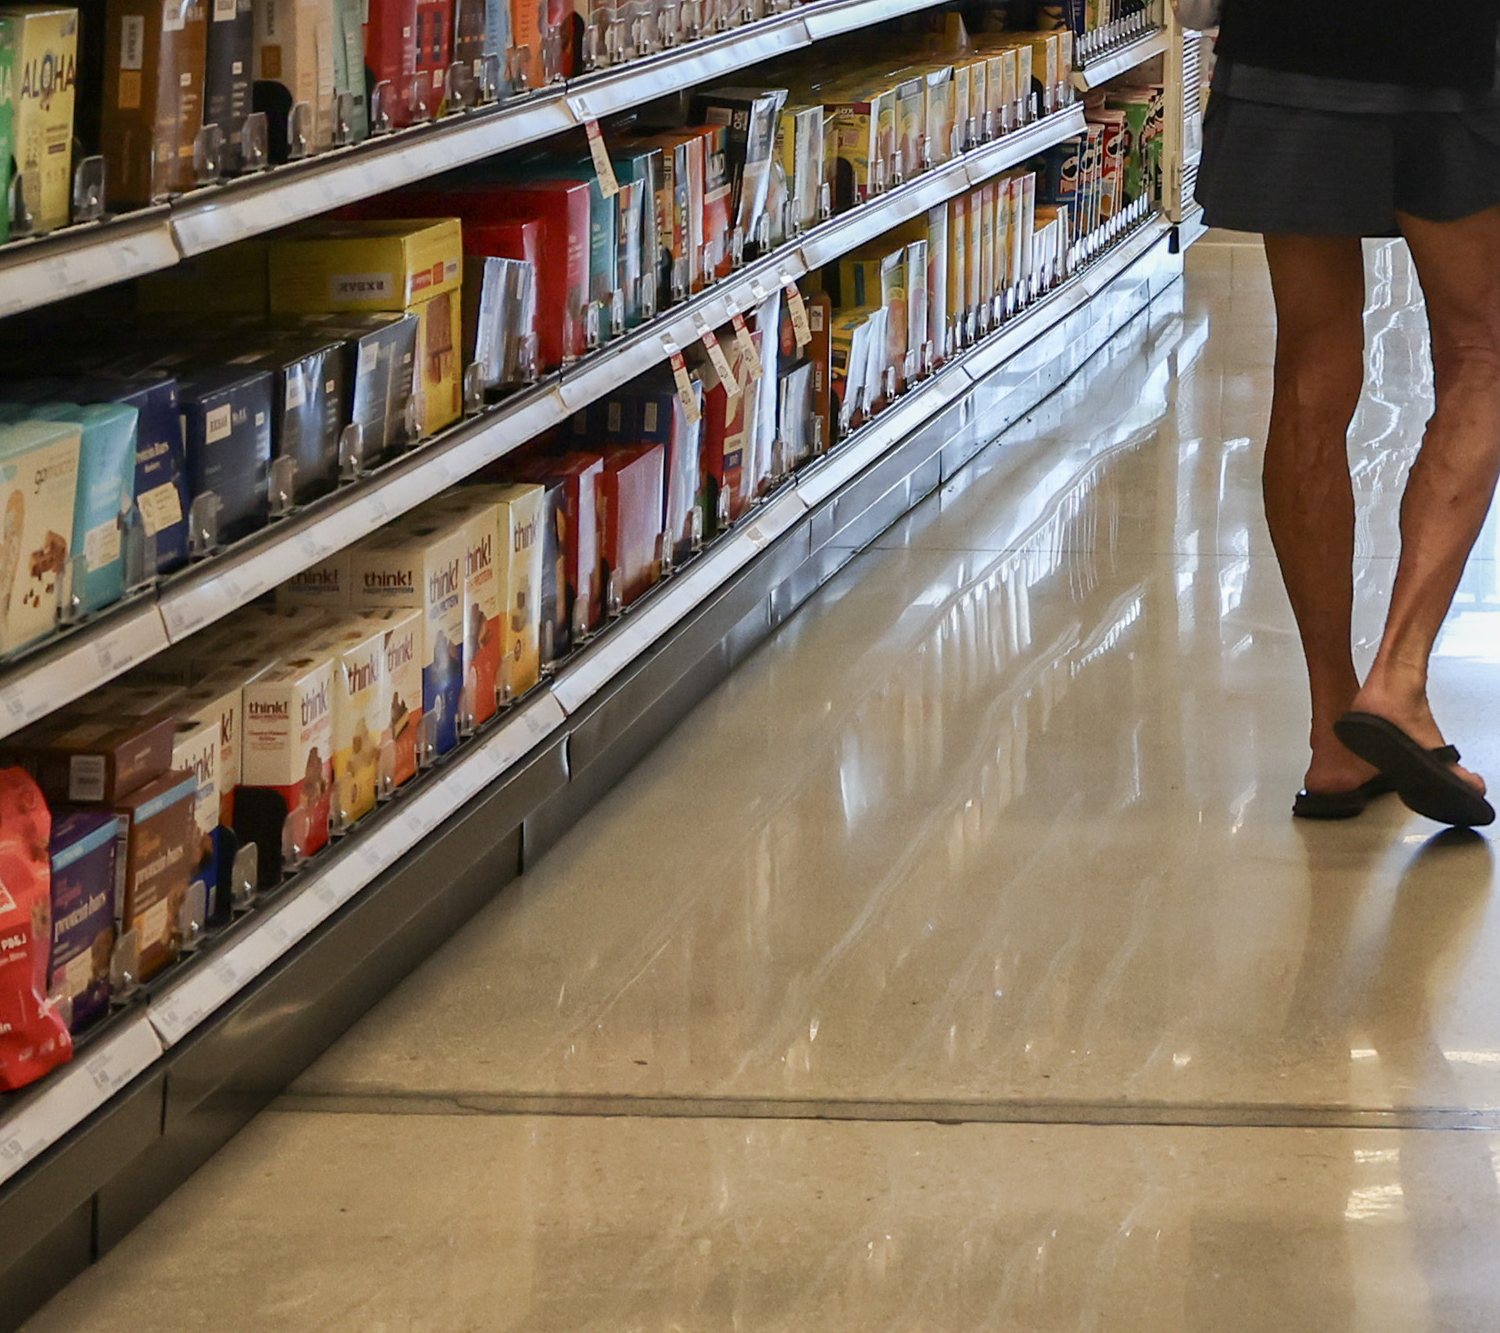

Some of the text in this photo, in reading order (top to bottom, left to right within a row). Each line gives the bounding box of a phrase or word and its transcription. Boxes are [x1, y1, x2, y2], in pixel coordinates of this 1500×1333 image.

[21, 54, 76, 97] ALOHA
[364, 570, 413, 587] think!
[429, 559, 460, 605] think!
[249, 700, 287, 713] think!
